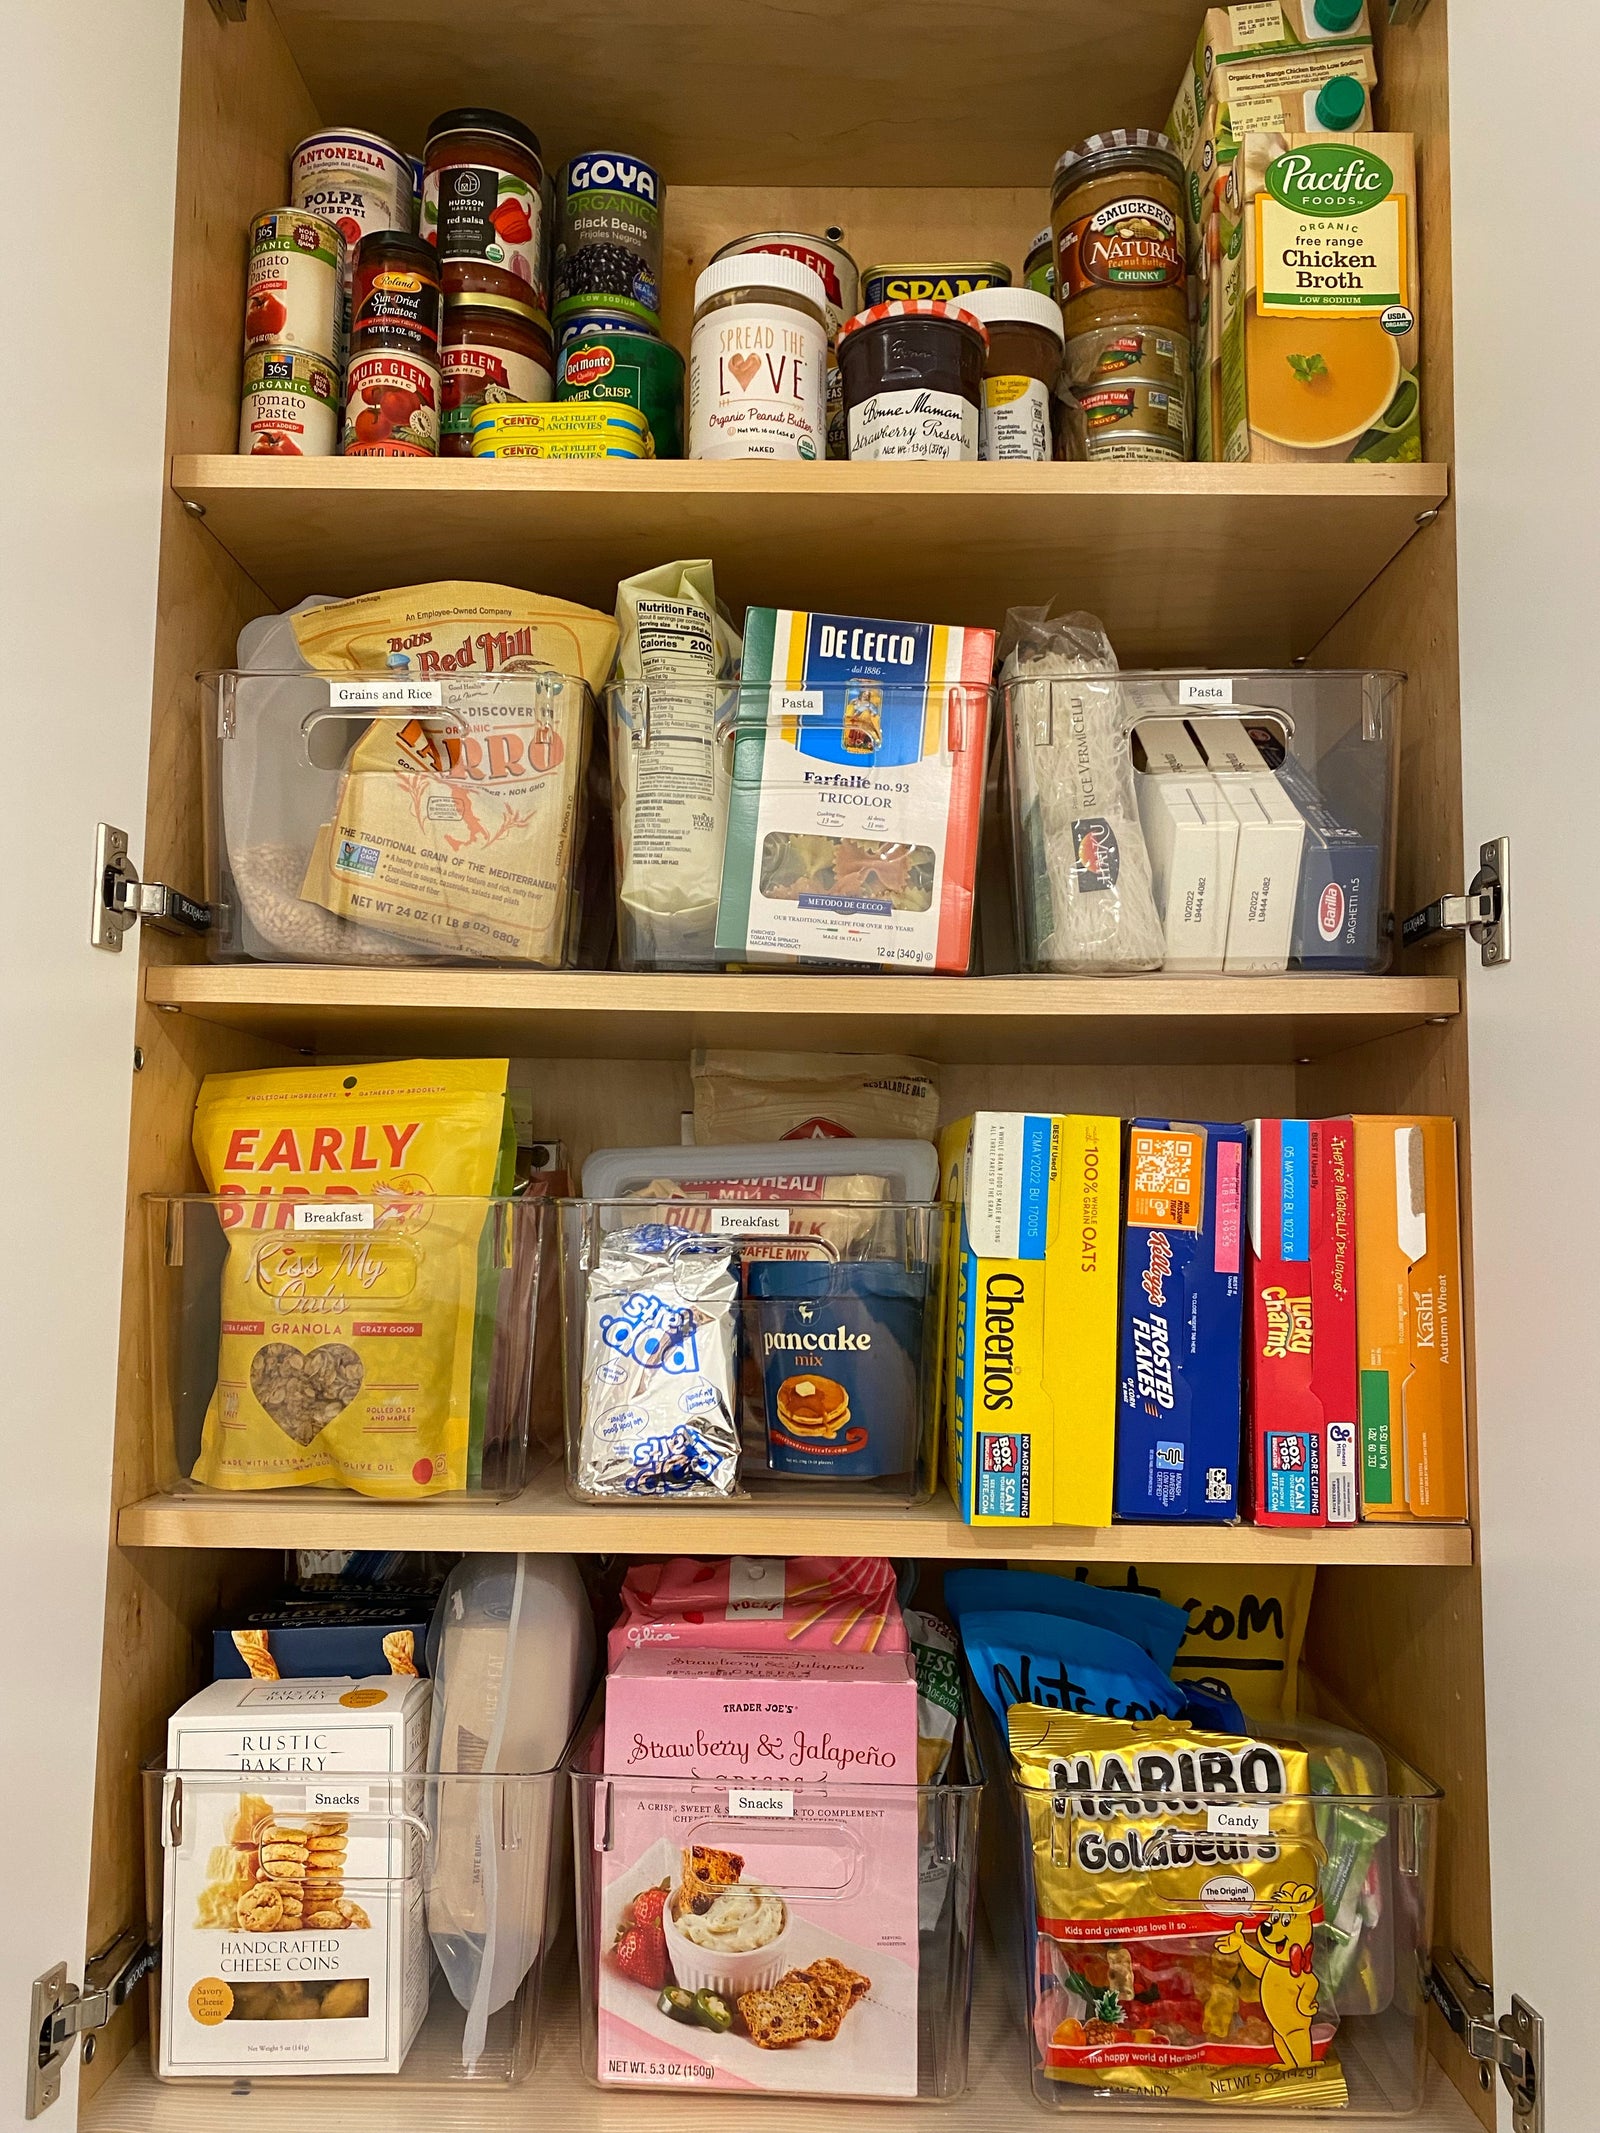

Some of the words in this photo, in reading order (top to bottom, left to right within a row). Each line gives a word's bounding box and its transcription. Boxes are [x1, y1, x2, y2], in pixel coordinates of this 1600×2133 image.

[1228, 73, 1251, 82] Organic
[1252, 71, 1265, 79] Free
[1266, 69, 1285, 77] Range
[1286, 66, 1309, 75] Chicken
[1340, 59, 1363, 67] Sodium
[299, 148, 386, 171] ANTONELLA
[571, 160, 655, 200] GOYA
[1277, 155, 1383, 195] Pacific
[304, 191, 364, 208] POLPA
[1303, 197, 1356, 205] FOODS
[463, 216, 484, 225] salsa
[1097, 202, 1171, 226] SMUCKER'S
[574, 216, 607, 231] Black
[611, 218, 647, 239] Beans
[1300, 222, 1359, 233] ORGANIC
[1090, 235, 1177, 265] NATURAL
[1296, 236, 1321, 246] free
[1326, 237, 1363, 249] range
[1282, 250, 1377, 268] Chicken
[380, 275, 414, 289] Roland
[1118, 271, 1160, 280] CHUNKY
[1296, 272, 1363, 288] Broth
[371, 292, 419, 309] Sun-Dried
[373, 305, 417, 320] Tomatoes
[720, 326, 774, 352] SPREAD
[783, 329, 805, 358] THE
[268, 364, 287, 376] 365
[568, 363, 579, 375] Del
[581, 356, 611, 370] Monte
[353, 362, 383, 384] MUIR
[390, 363, 426, 388] GLEN
[361, 376, 412, 389] ORGANIC
[252, 380, 307, 393] ORGANIC
[593, 384, 631, 398] CRISP
[252, 395, 305, 409] Tomato
[863, 398, 902, 425] Bonne
[905, 393, 962, 420] Maman
[257, 407, 297, 421] Paste
[503, 415, 540, 426] CENTO
[709, 411, 745, 427] Organic
[747, 408, 785, 423] Peanut
[787, 414, 813, 433] Butter
[547, 422, 602, 430] ANCHOVIES
[406, 613, 415, 621] An
[417, 607, 477, 619] Employee-Owned
[479, 607, 512, 617] Company
[639, 603, 684, 614] Nutrition
[687, 608, 711, 622] Facts
[387, 630, 433, 653] Bob's
[641, 639, 677, 648] Calories
[691, 640, 712, 653] 200
[820, 625, 848, 658] DE
[851, 628, 915, 664] CECCO
[417, 635, 476, 681] Red
[476, 625, 534, 672] Mill
[339, 688, 378, 700] Grains
[382, 689, 404, 700] and
[408, 689, 432, 700] Rice
[1189, 687, 1223, 697] Pasta
[782, 697, 814, 709] Pasta
[1071, 698, 1090, 775] VERMICELLI
[803, 771, 871, 789] Farfalle
[874, 783, 893, 792] no.
[895, 783, 909, 793] 93
[819, 792, 892, 808] TRICOLOR
[360, 832, 416, 855] TRADITIONAL
[421, 849, 448, 862] GRAIN
[451, 857, 465, 866] OF
[468, 860, 484, 872] THE
[351, 894, 372, 908] NET
[376, 900, 394, 913] WT
[396, 906, 411, 918] 24
[414, 910, 428, 921] OZ
[1185, 891, 1195, 922] 10/2022
[1324, 888, 1337, 928] Barilla
[1346, 892, 1359, 944] SPAGHETTI
[877, 947, 885, 956] 12
[1052, 1125, 1060, 1144] BEST
[223, 1123, 423, 1173] EARLY
[1083, 1147, 1099, 1193] 100%
[303, 1212, 364, 1224] Breakfast
[1090, 1197, 1098, 1225] WHOLE
[720, 1216, 780, 1228] Breakfast
[1082, 1226, 1097, 1273] OATS
[1142, 1230, 1173, 1307] Kellogg's
[1438, 1274, 1449, 1313] Wheat
[1261, 1286, 1290, 1358] Charms
[1287, 1296, 1314, 1354] Lucky
[1416, 1291, 1435, 1348] Kashi
[271, 1324, 342, 1334] GRANOLA
[764, 1326, 871, 1355] pancake
[985, 1273, 1025, 1411] Cheerios
[1439, 1317, 1451, 1365] Autumn
[795, 1352, 823, 1367] mix
[1133, 1317, 1157, 1398] FLAKES
[1150, 1313, 1174, 1409] FROSTED
[1000, 1436, 1013, 1467] BOX
[1022, 1436, 1028, 1450] NO
[992, 1439, 1001, 1472] TOPS
[1006, 1478, 1015, 1512] SCAN
[627, 1628, 680, 1644] Glico
[723, 1704, 762, 1713] TRADER
[764, 1703, 795, 1714] JOE'S
[241, 1735, 328, 1751] RUSTIC
[627, 1729, 750, 1765] Strawberry
[757, 1734, 785, 1760] &
[789, 1730, 896, 1771] Jalapeño
[241, 1757, 328, 1772] BAKERY
[1048, 1742, 1288, 1821] HARIBO
[315, 1794, 360, 1805] Snacks
[739, 1797, 783, 1810] Snacks
[1217, 1814, 1259, 1829] Candy
[1206, 1888, 1219, 1896] The
[1221, 1886, 1249, 1896] Original
[1064, 1926, 1080, 1936] Kids
[1081, 1925, 1102, 1935] and
[1103, 1924, 1148, 1937] grown-ups
[1149, 1922, 1165, 1932] love
[1167, 1922, 1176, 1931] it
[1178, 1922, 1187, 1931] so
[221, 1939, 340, 1955] HANDCRAFTED
[221, 1958, 282, 1972] CHEESE
[286, 1957, 340, 1970] COINS
[197, 1987, 222, 1997] Savory
[196, 1997, 224, 2007] Cheese
[198, 2008, 222, 2017] Coins
[259, 2045, 278, 2053] Weight
[608, 2060, 628, 2073] NET
[630, 2062, 647, 2074] WT.
[649, 2062, 665, 2074] 5.3
[668, 2063, 682, 2076] OZ
[683, 2064, 715, 2080] (150g)
